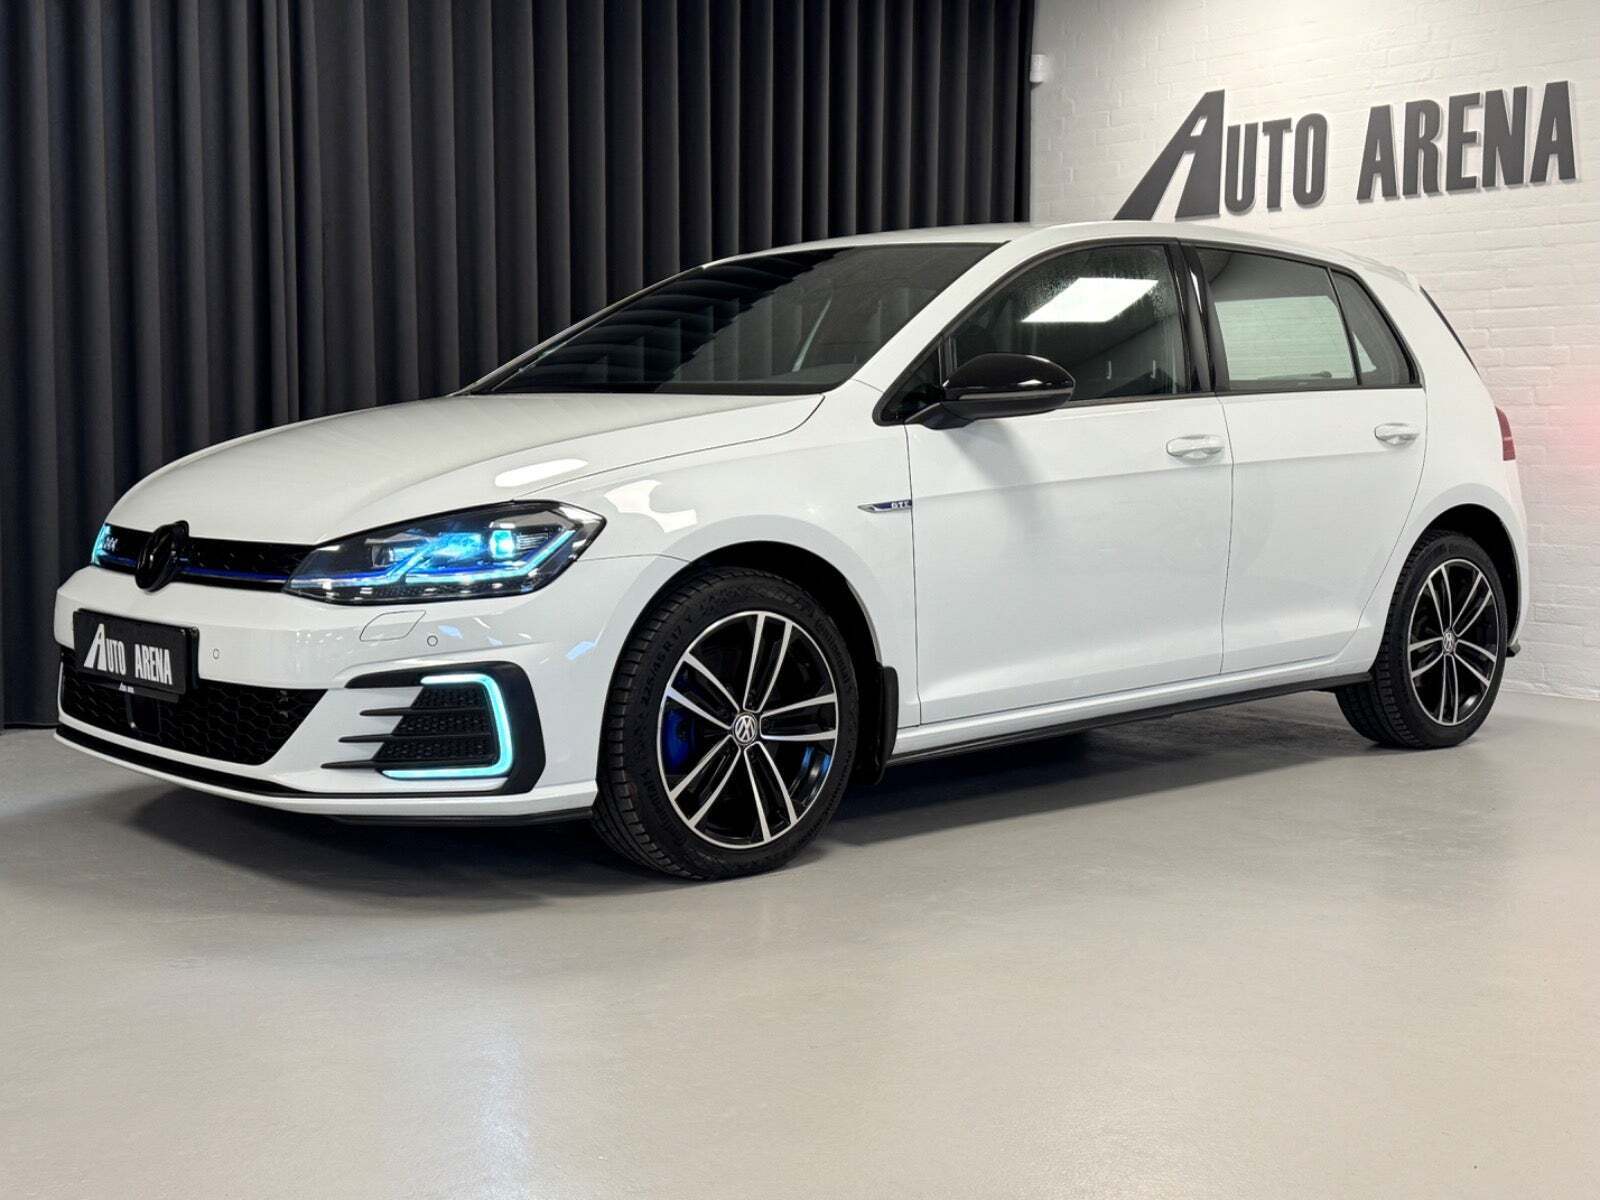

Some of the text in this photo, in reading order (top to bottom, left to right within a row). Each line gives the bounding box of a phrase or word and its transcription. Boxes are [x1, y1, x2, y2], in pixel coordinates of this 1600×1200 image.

[1112, 80, 1577, 221] AUTO ARENA
[84, 623, 173, 685] AUTO ARENA
